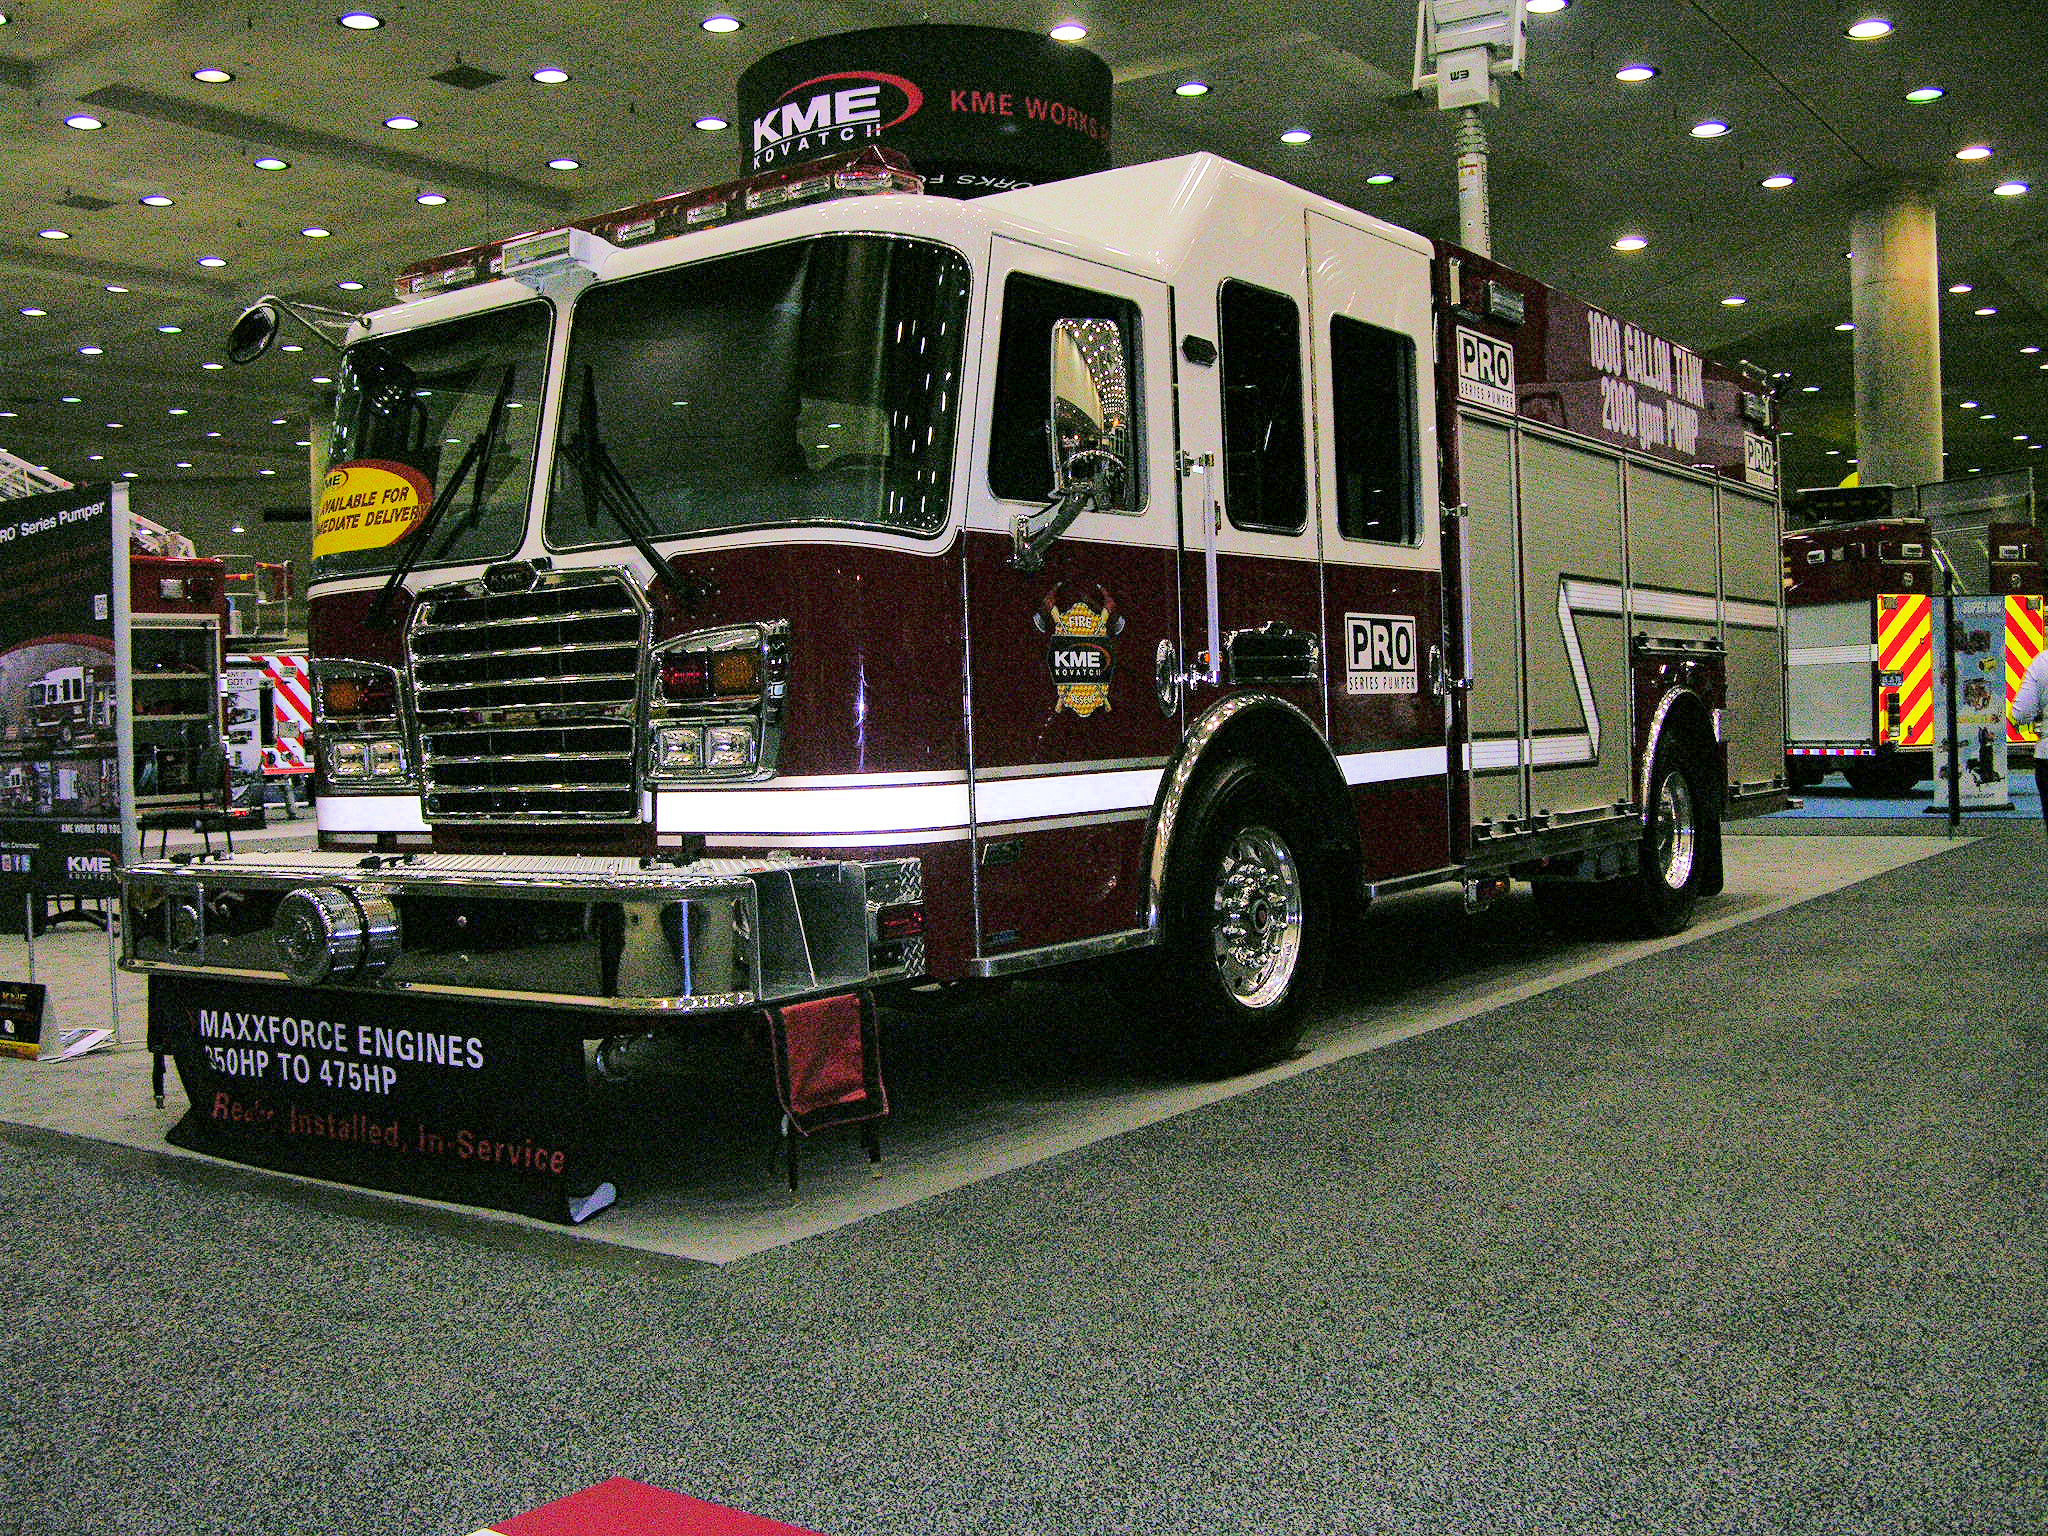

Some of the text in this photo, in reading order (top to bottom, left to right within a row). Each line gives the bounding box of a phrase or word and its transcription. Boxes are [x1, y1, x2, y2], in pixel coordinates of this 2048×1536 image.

[753, 85, 881, 152] KME
[950, 90, 1014, 117] KME
[1025, 96, 1099, 140] WORKS
[753, 122, 881, 171] KOVATCH
[956, 174, 1034, 191] ORKS
[1462, 336, 1510, 387] PRO
[1587, 309, 1705, 410] 1000 GALLON TANK
[1460, 381, 1513, 410] SERIES PUMPER
[1600, 375, 1637, 438] 2000
[1666, 399, 1699, 457] PUMP
[1748, 439, 1772, 472] PRO
[381, 486, 410, 504] FOR
[20, 516, 57, 537] Series
[58, 501, 105, 526] Pumper
[1068, 615, 1093, 628] FIRE
[1055, 651, 1101, 668] KME
[1352, 624, 1411, 667] PRO
[1055, 668, 1101, 676] KOVATCH
[1349, 676, 1416, 690] SERIES PUMPER
[67, 856, 112, 872] KME
[200, 1009, 485, 1069] MAXXFORCE ENGINES
[277, 1052, 310, 1084] TO
[320, 1058, 397, 1095] 475HP
